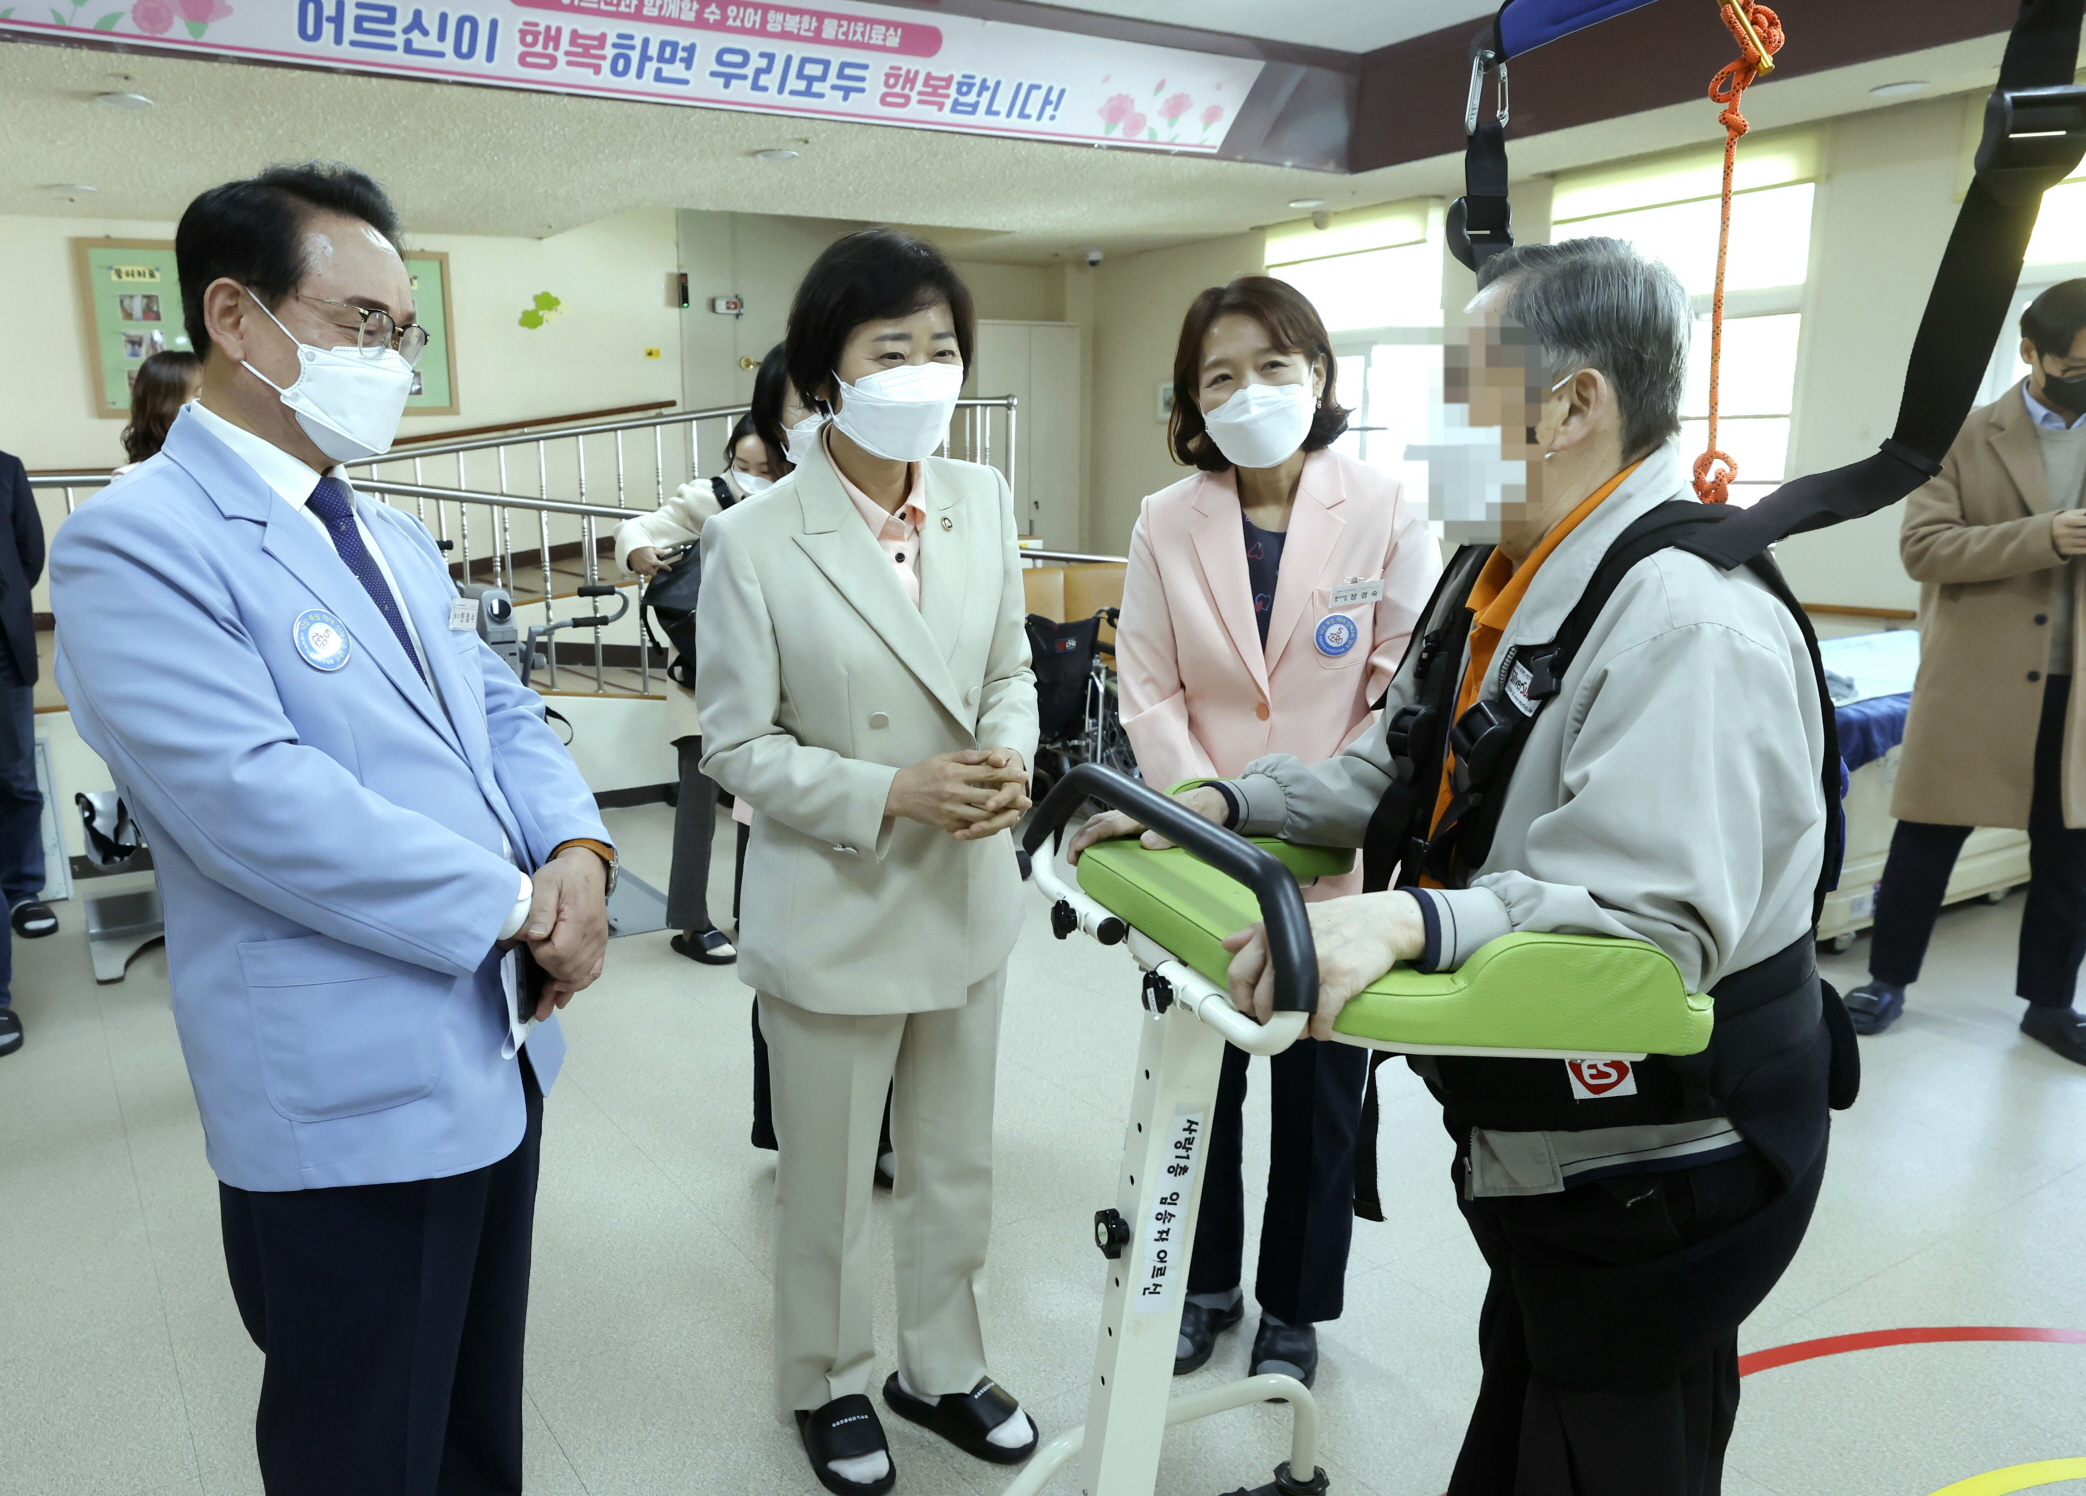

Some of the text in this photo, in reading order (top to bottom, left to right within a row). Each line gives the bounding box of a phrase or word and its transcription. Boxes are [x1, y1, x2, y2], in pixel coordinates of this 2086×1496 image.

[642, 0, 699, 21] 함께할
[703, 3, 721, 23] 수
[726, 5, 762, 30] 있어
[766, 10, 818, 37] 행복한
[821, 18, 903, 48] 물리치료실
[297, 0, 1067, 122] 어르신이 행복하면 우리모두 행복합니다!
[322, 629, 332, 638] 5
[1327, 632, 1344, 645] ZERO
[1167, 1119, 1199, 1178] 사랑1층
[1142, 1249, 1169, 1296] 어르신
